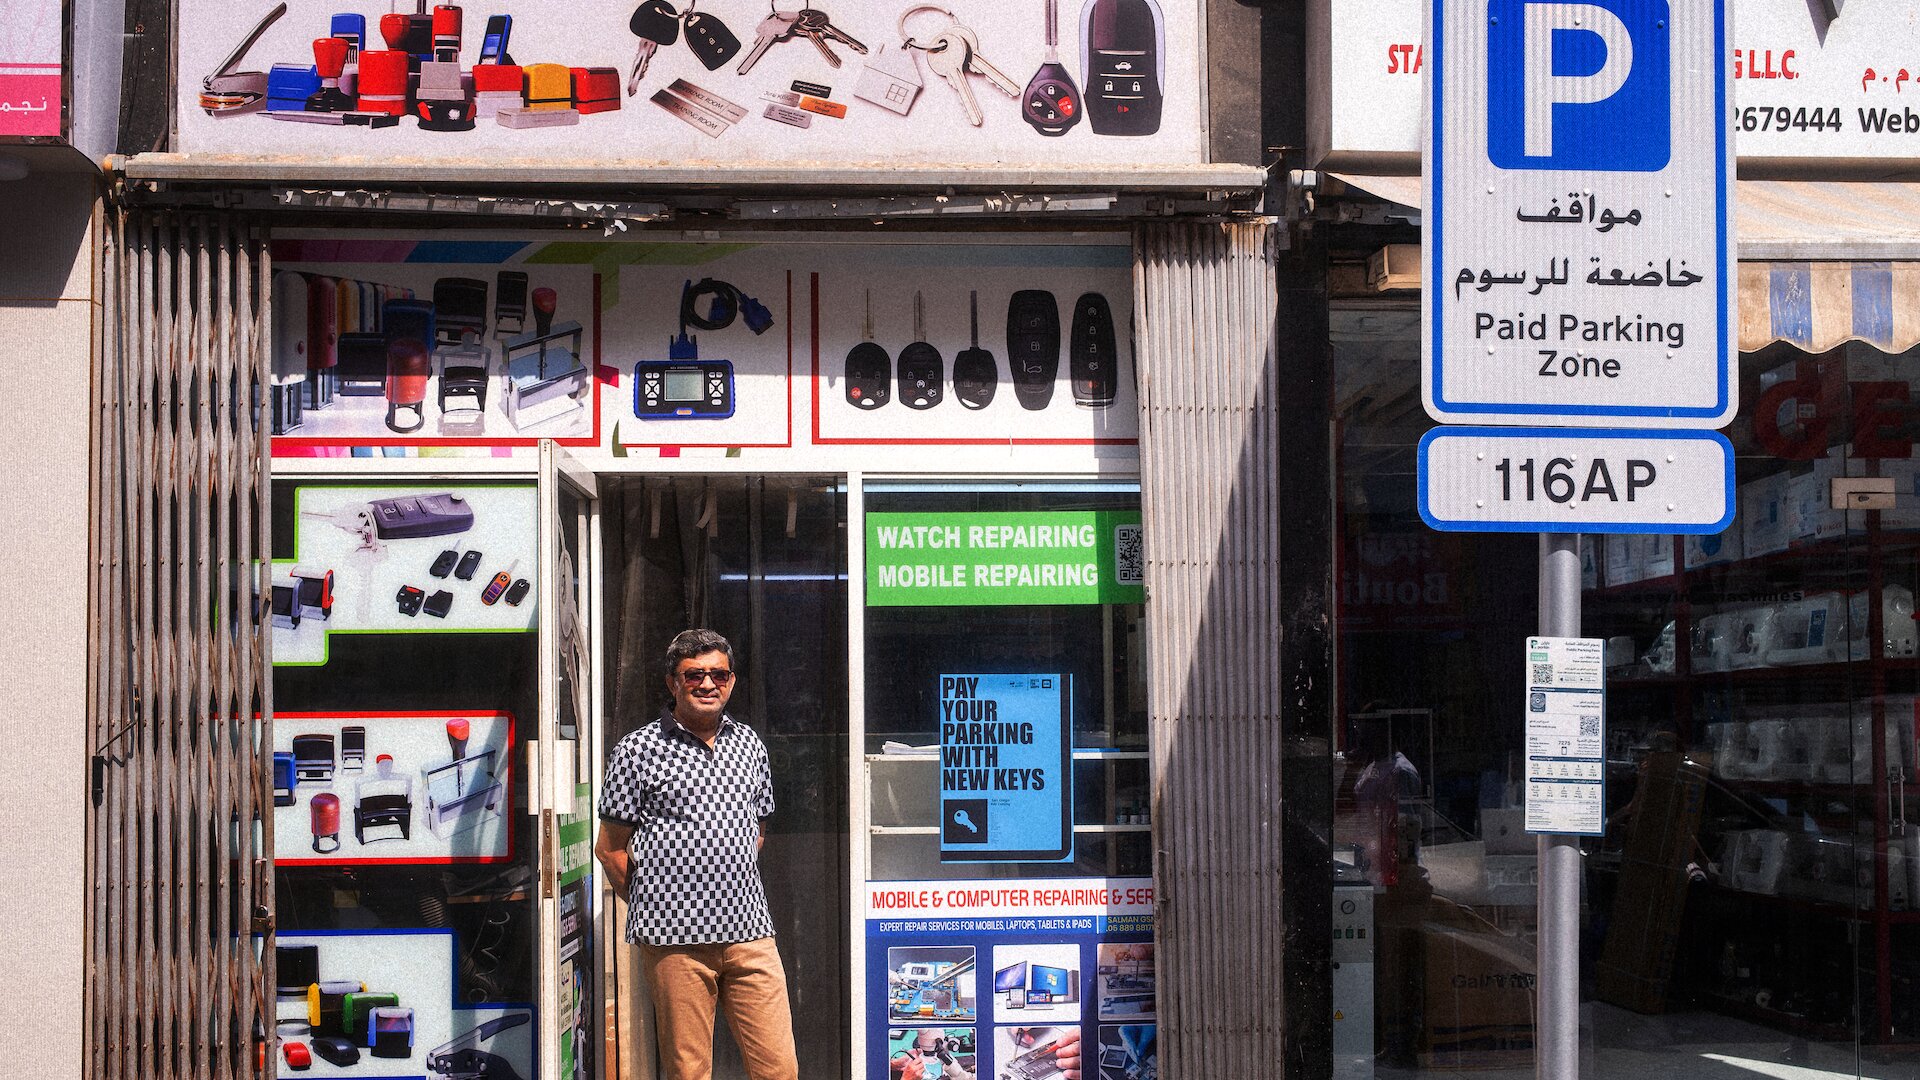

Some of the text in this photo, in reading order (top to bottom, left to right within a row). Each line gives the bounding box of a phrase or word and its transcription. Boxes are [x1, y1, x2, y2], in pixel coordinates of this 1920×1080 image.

[1749, 49, 1800, 80] L.L.C.
[698, 116, 718, 131] ROOM
[1736, 106, 1842, 132] 679444
[1516, 193, 1642, 233] مواقف
[1455, 256, 1703, 301] خاضعة للرسوم
[1475, 312, 1684, 349] Paid Parking
[1538, 350, 1621, 378] Zone
[1495, 457, 1657, 503] 116AP
[877, 524, 1096, 549] WATCH REPAIRING
[878, 563, 1099, 588] MOBILE REPAIRING
[943, 677, 979, 699] PAY
[942, 700, 998, 721] YOUR
[943, 722, 1033, 745] PARKING
[943, 745, 998, 768] WITH
[943, 768, 1045, 791] NEW KEYS
[872, 891, 928, 909] MOBILE
[932, 891, 943, 908] &
[947, 889, 1029, 908] COMPUTER
[1033, 889, 1108, 907] REPAIRING
[1112, 889, 1123, 905] &
[880, 919, 1092, 932] EXPERT REPAIR SERVICES FOR MOBILES, LAPTOPS, TABLETS & IPADS
[1107, 916, 1139, 924] SALMAN
[1119, 924, 1135, 932] 889
[1136, 924, 1154, 932] 8817
